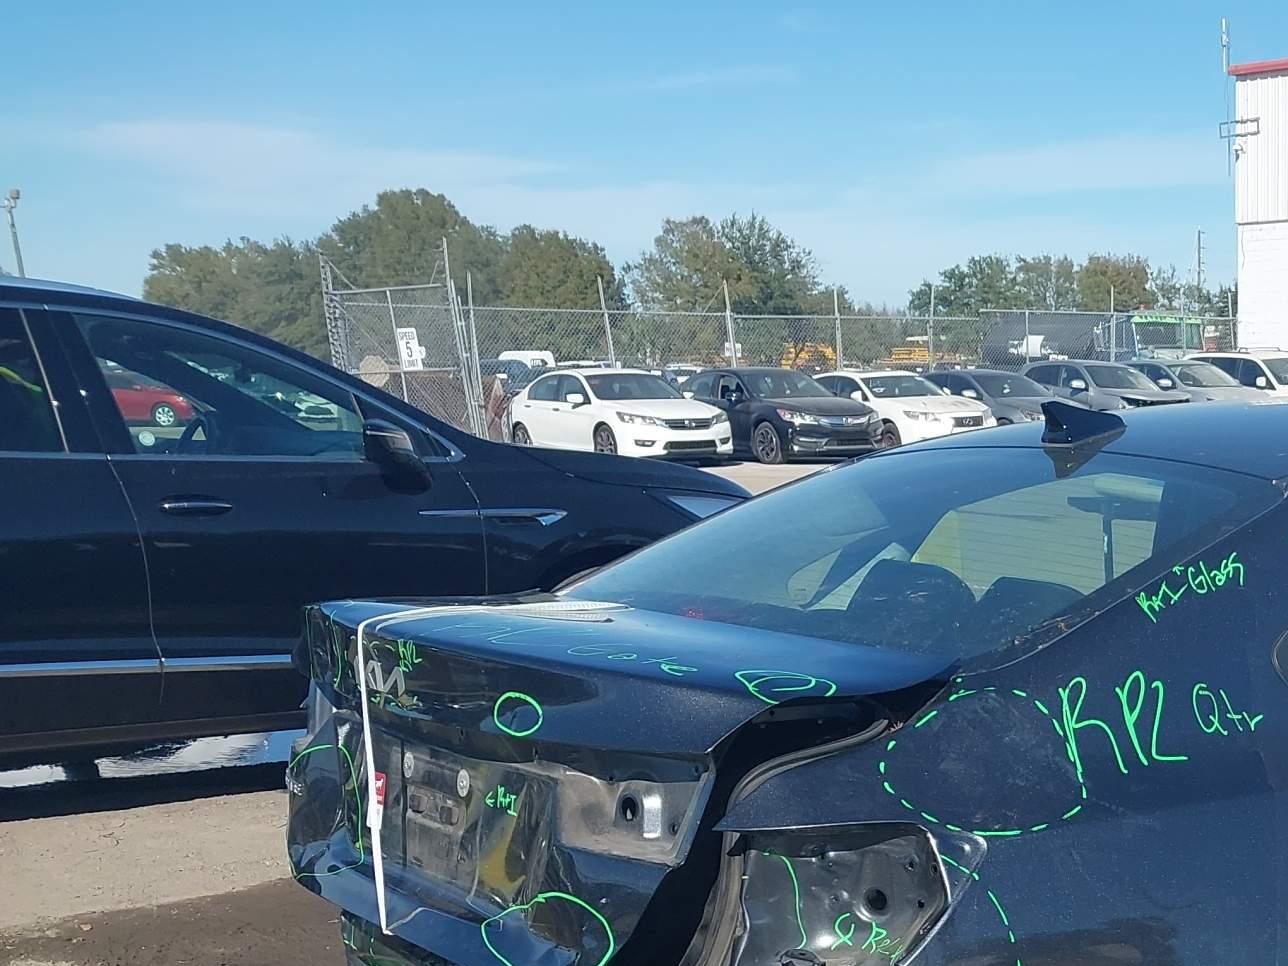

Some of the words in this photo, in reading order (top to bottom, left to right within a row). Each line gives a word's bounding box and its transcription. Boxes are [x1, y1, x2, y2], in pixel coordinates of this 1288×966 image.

[405, 341, 413, 358] 5
[1187, 552, 1245, 594] Glass
[1193, 683, 1264, 736] Qtr
